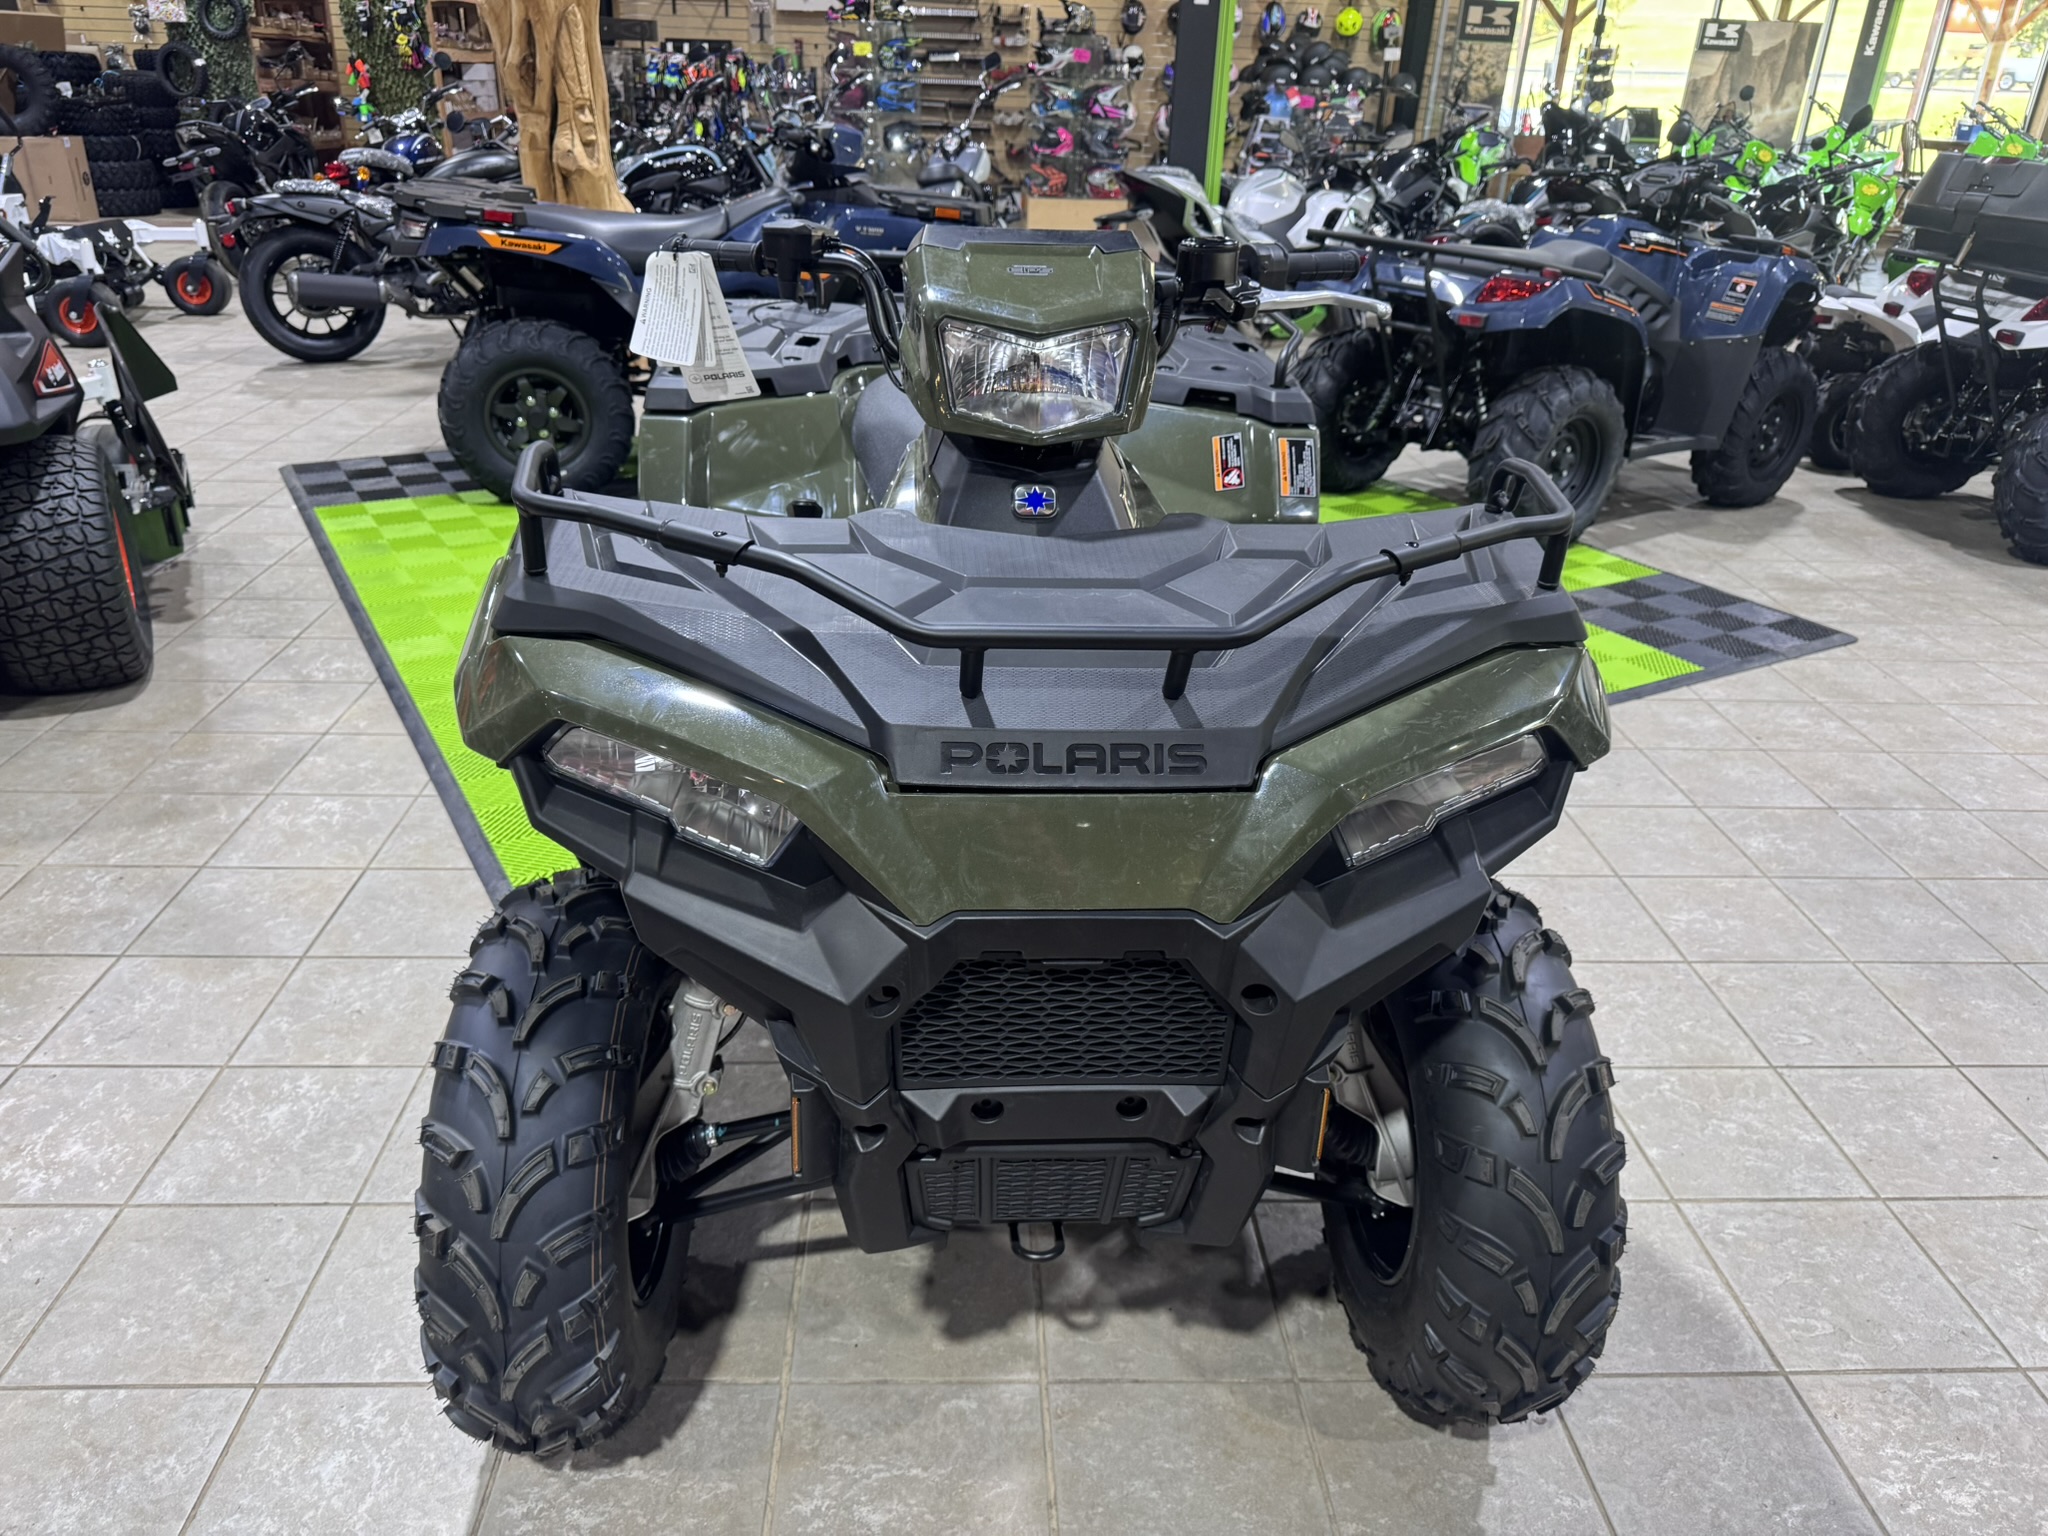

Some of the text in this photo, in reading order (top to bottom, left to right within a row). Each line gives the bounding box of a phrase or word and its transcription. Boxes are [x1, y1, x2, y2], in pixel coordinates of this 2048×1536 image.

[1465, 24, 1511, 36] Kawasaki
[1702, 37, 1739, 46] Kawasaki
[500, 238, 546, 251] Kawasaki
[641, 288, 652, 318] WARNING
[703, 370, 746, 381] POLARIS
[940, 742, 1208, 776] POLARIS
[679, 1012, 702, 1077] POLARIS
